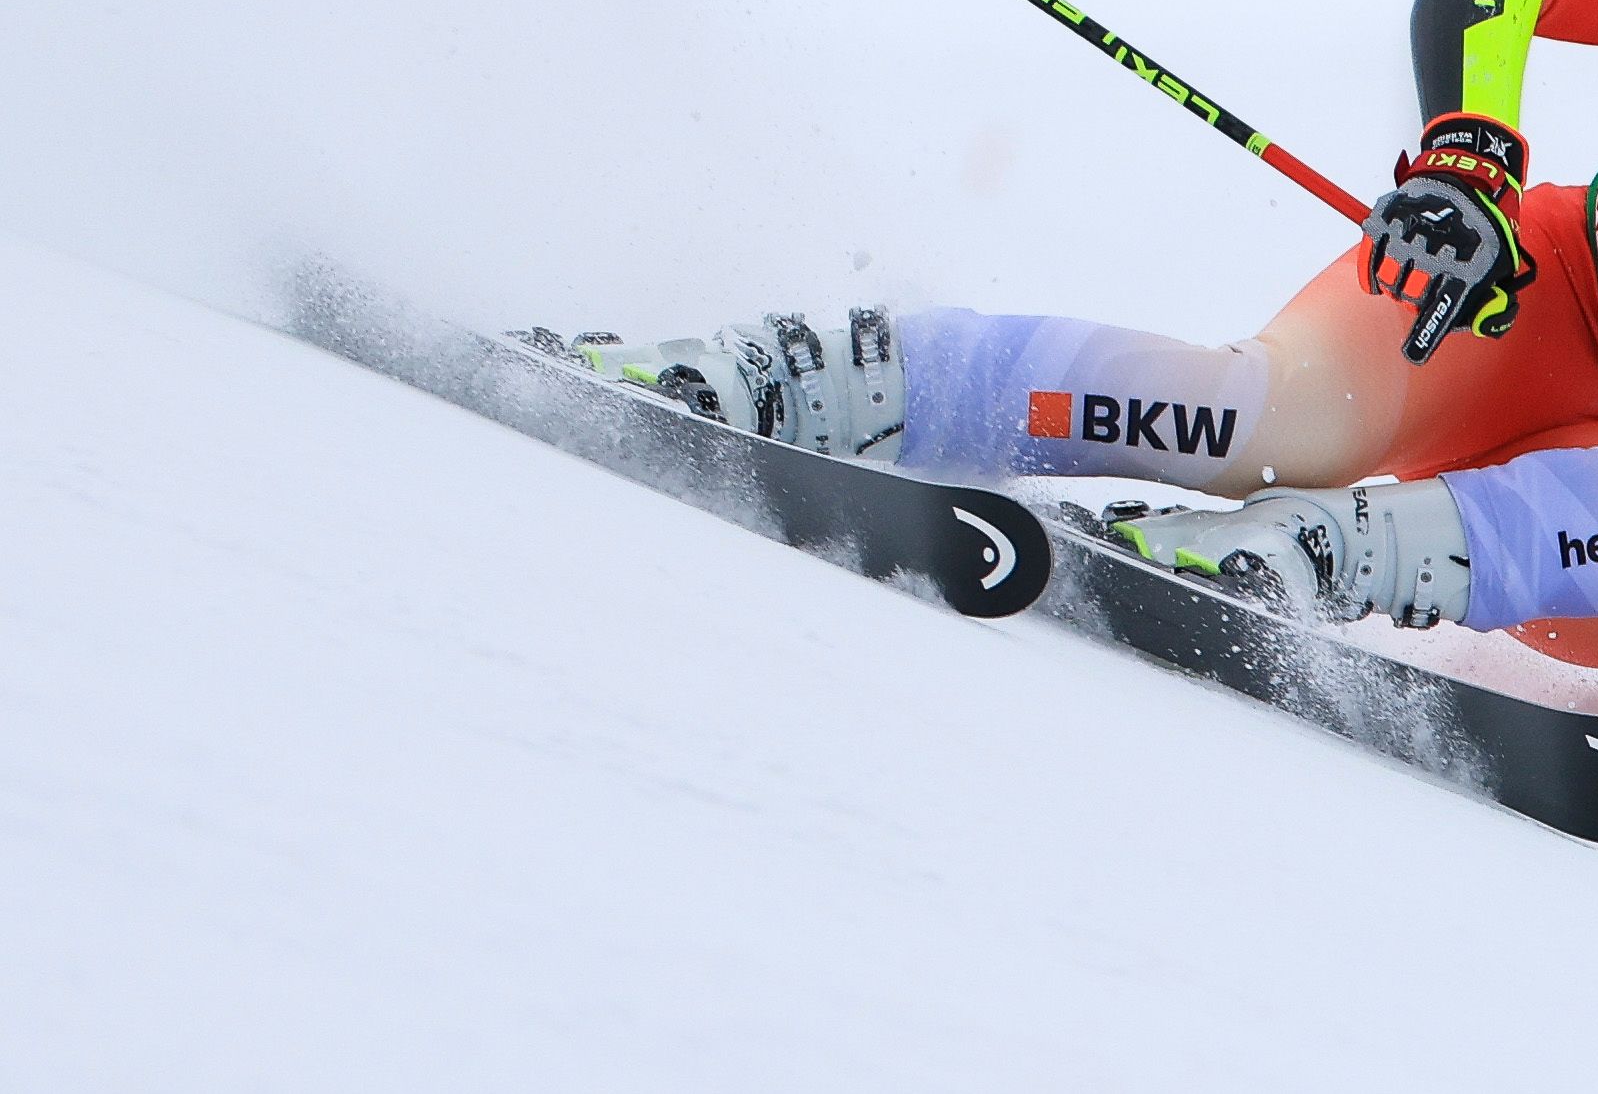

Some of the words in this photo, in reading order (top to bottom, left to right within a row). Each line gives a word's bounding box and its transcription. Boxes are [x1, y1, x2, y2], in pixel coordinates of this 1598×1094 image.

[1115, 45, 1220, 125] LEKI
[1426, 153, 1499, 179] LEKI
[1415, 293, 1453, 350] reusch
[1081, 393, 1238, 459] BKW
